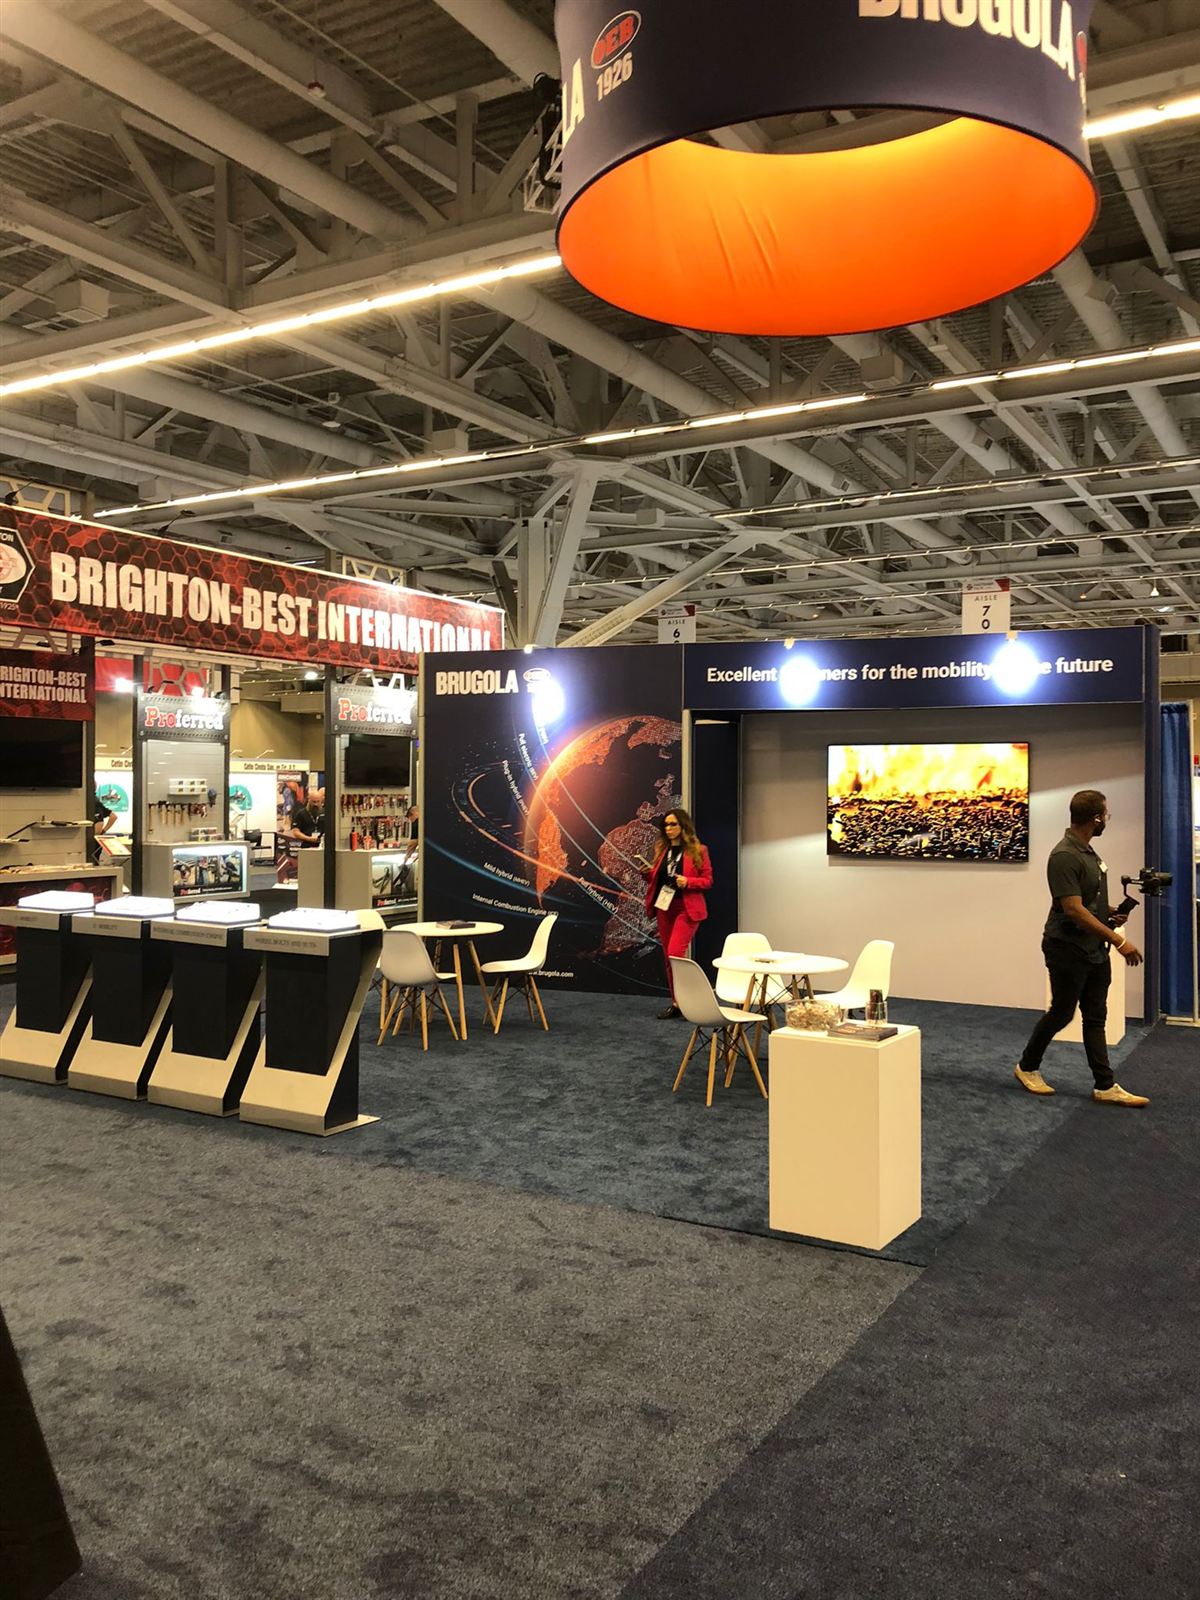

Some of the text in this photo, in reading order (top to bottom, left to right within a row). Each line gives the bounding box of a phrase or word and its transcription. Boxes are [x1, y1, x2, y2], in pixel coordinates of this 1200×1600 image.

[596, 52, 633, 101] 1926
[50, 551, 312, 638] BRIGHTON-BEST
[982, 604, 991, 616] 7
[673, 629, 680, 638] 6
[707, 666, 777, 682] Excellent
[861, 664, 886, 680] for
[890, 663, 918, 680] the
[922, 660, 992, 681] mobility
[1055, 657, 1113, 674] future
[435, 669, 519, 695] BRUGOLA
[145, 706, 224, 730] Proferred
[483, 862, 497, 873] Mild
[496, 867, 513, 880] hybrid
[472, 893, 493, 905] Internal
[493, 900, 527, 913] Combustion
[527, 906, 547, 916] Engine
